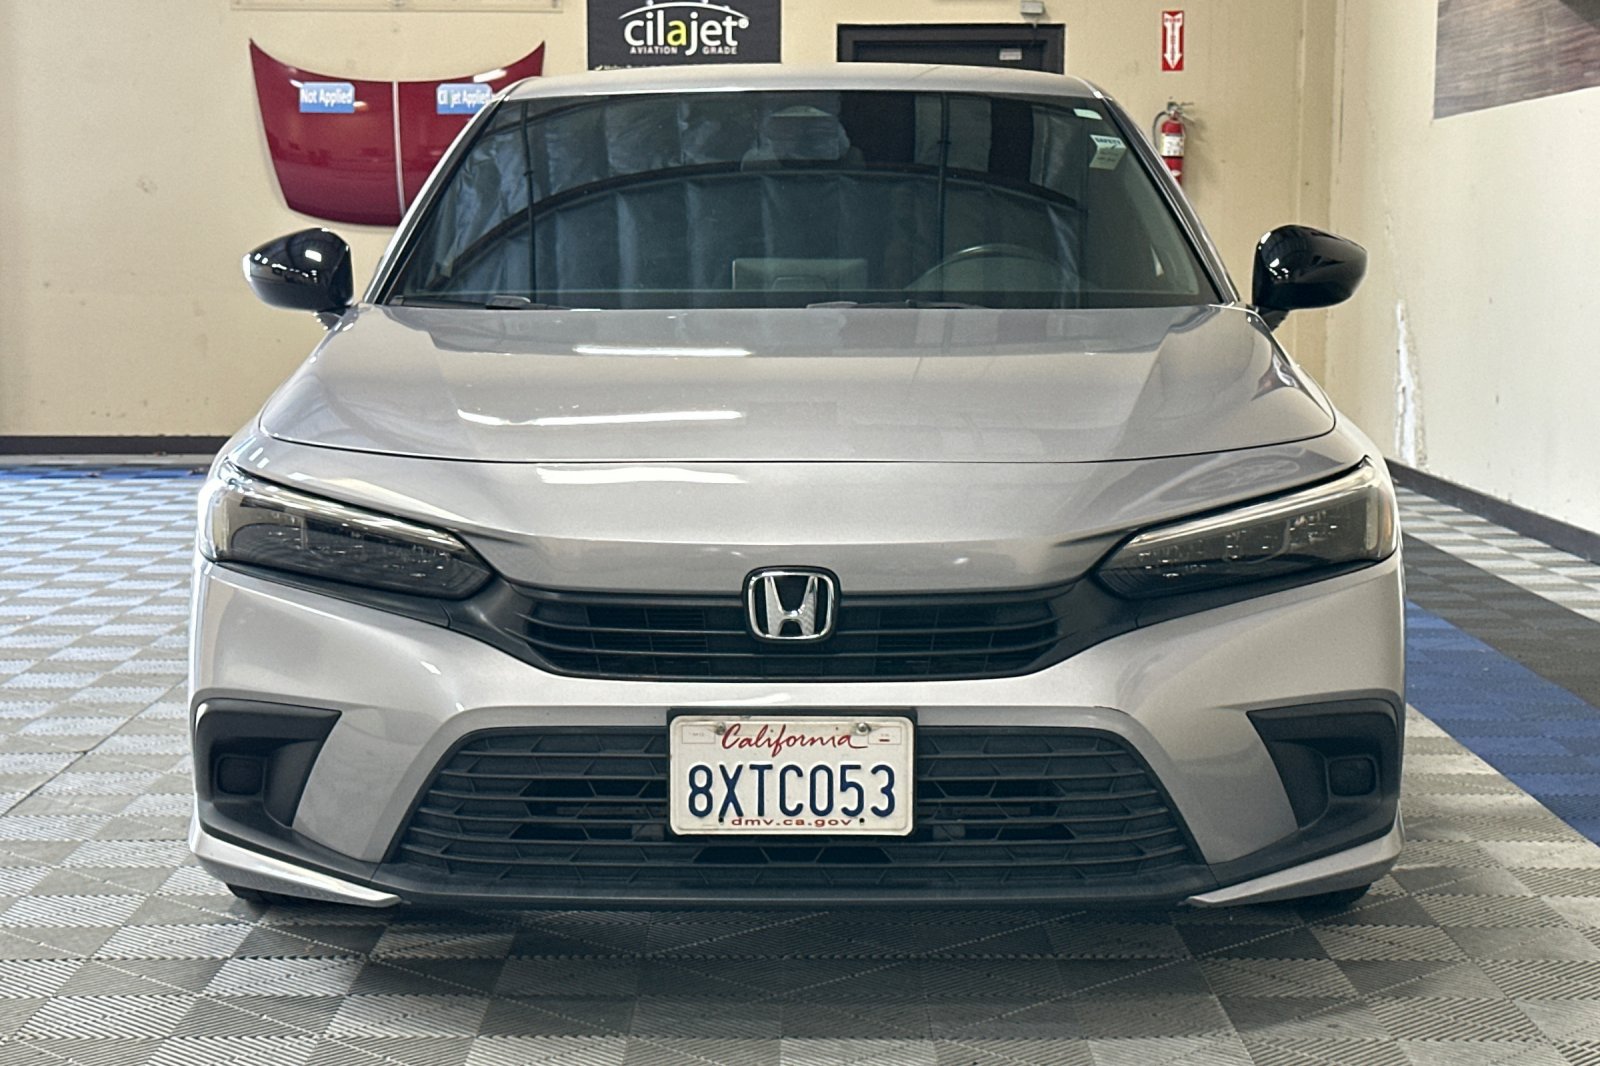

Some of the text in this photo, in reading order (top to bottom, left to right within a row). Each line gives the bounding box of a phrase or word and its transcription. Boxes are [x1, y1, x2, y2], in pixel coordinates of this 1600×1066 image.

[629, 46, 738, 55] AVIATION GRADE
[300, 87, 353, 107] Not Applied
[721, 723, 869, 758] California
[688, 763, 896, 818] 8XTC053
[731, 817, 852, 828] dmv.ca.gov
